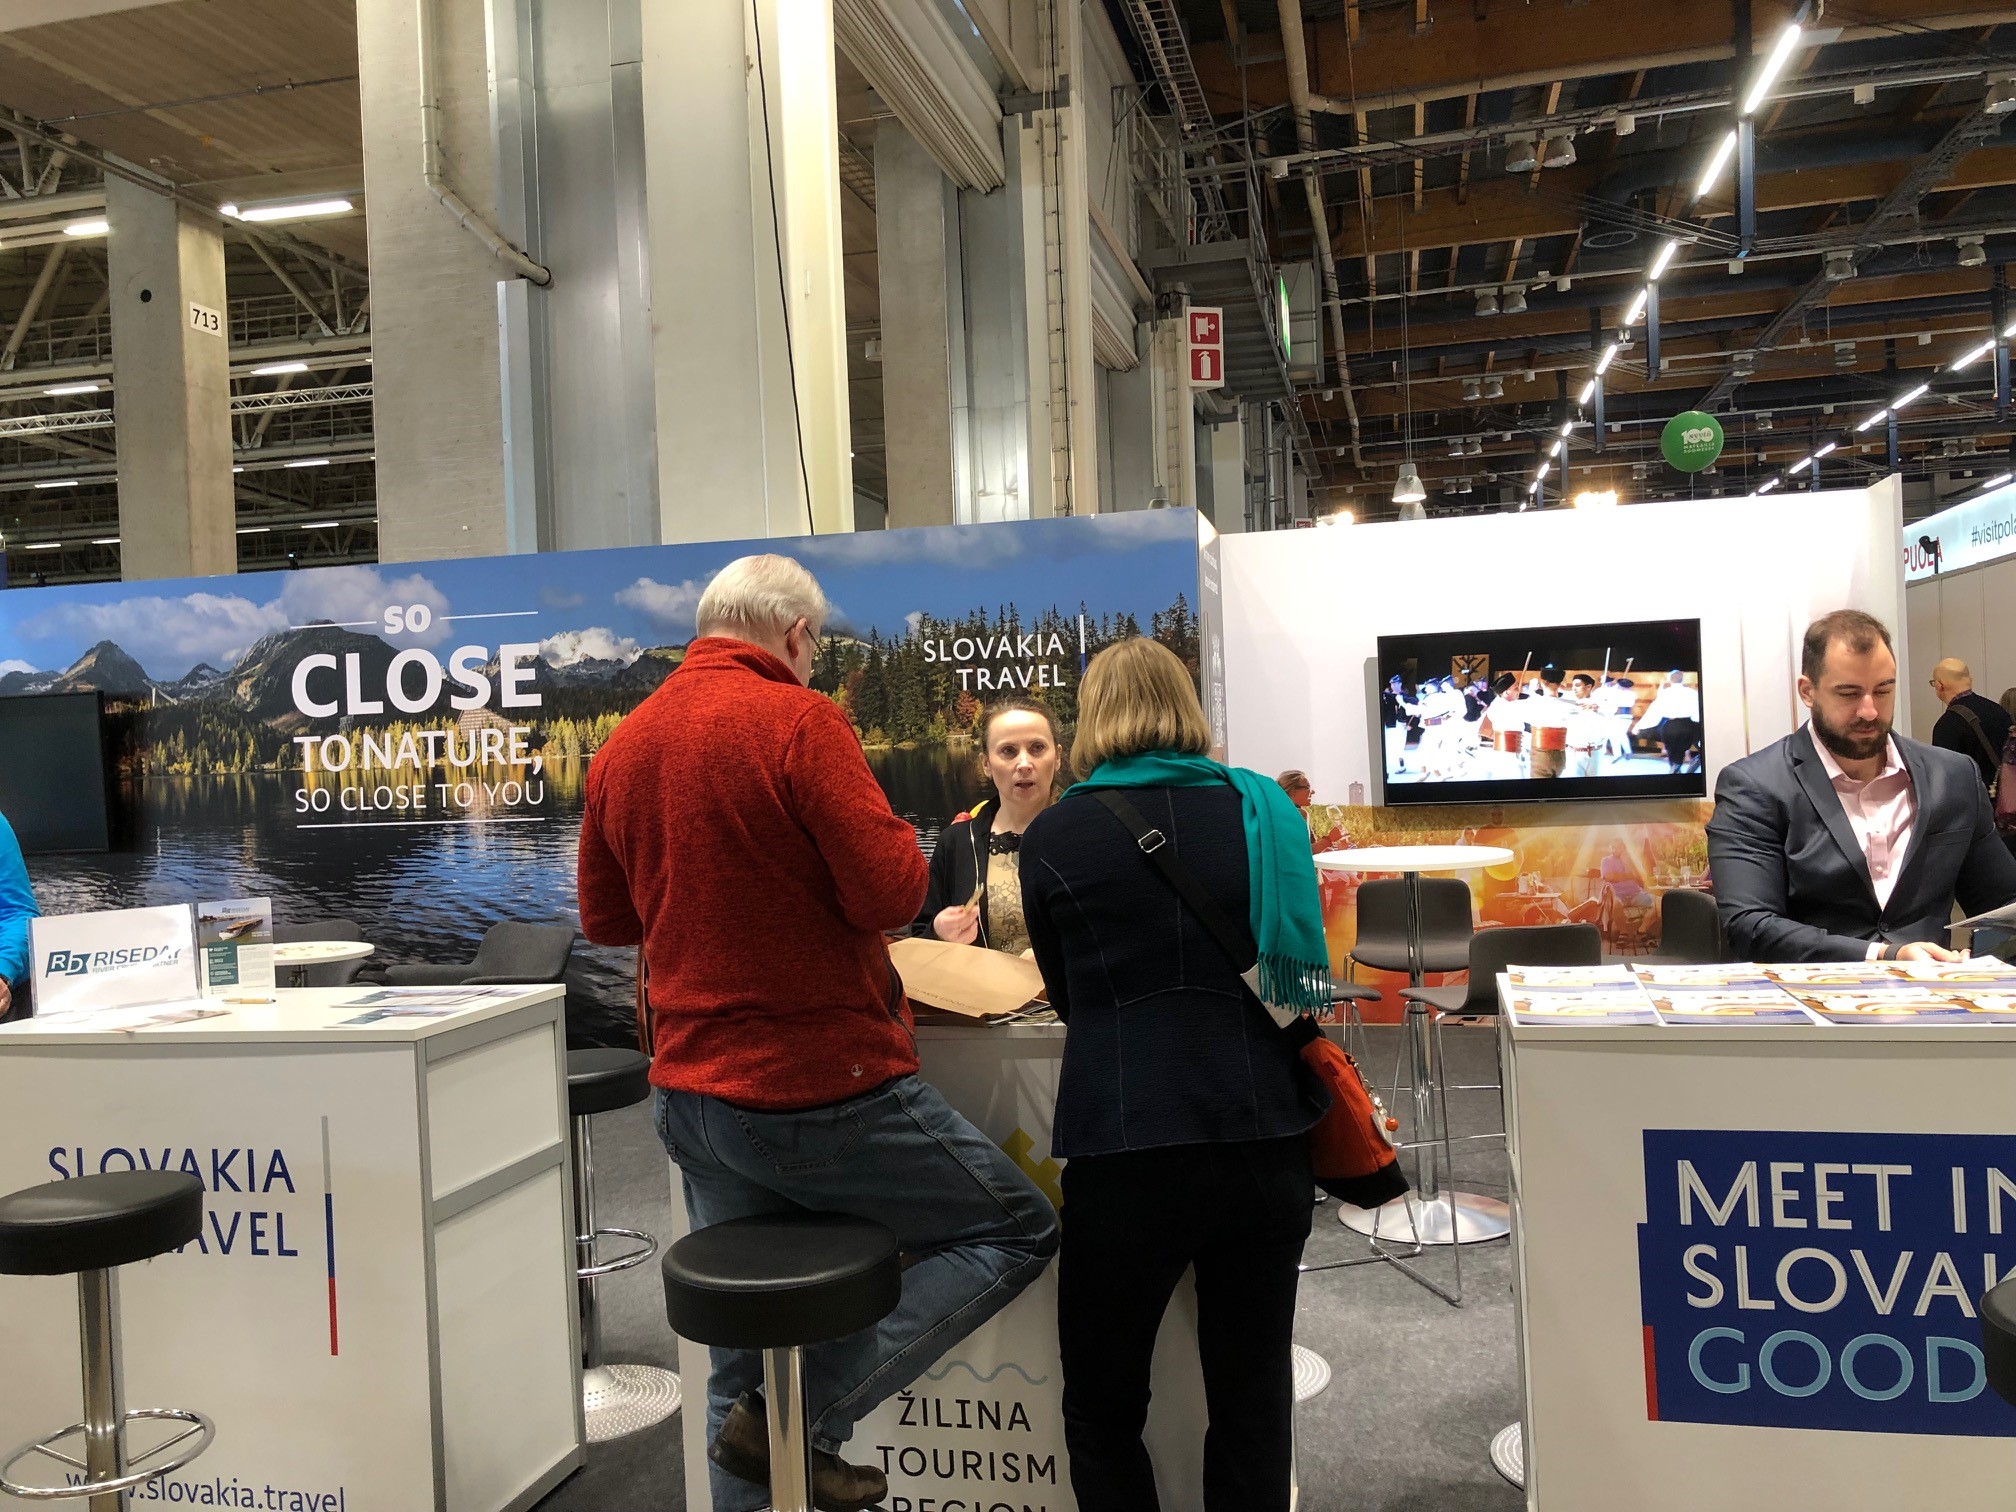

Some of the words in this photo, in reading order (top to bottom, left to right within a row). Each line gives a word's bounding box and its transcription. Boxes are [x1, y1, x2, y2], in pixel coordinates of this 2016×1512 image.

[193, 308, 219, 331] 713
[384, 604, 432, 635] SO
[923, 632, 1065, 663] SLOVAKIA
[291, 642, 543, 718] CLOSE
[955, 664, 1067, 691] TRAVEL
[293, 734, 351, 773] TO
[363, 726, 543, 776] NATURE,
[295, 787, 331, 813] SO
[340, 784, 427, 812] CLOSE
[435, 782, 475, 808] TO
[483, 780, 545, 806] YOU
[1677, 1160, 1912, 1232] MEET
[1688, 1326, 1988, 1404] GOOD
[897, 1389, 1032, 1433] ŽILINA
[876, 1445, 1056, 1486] TOURISM
